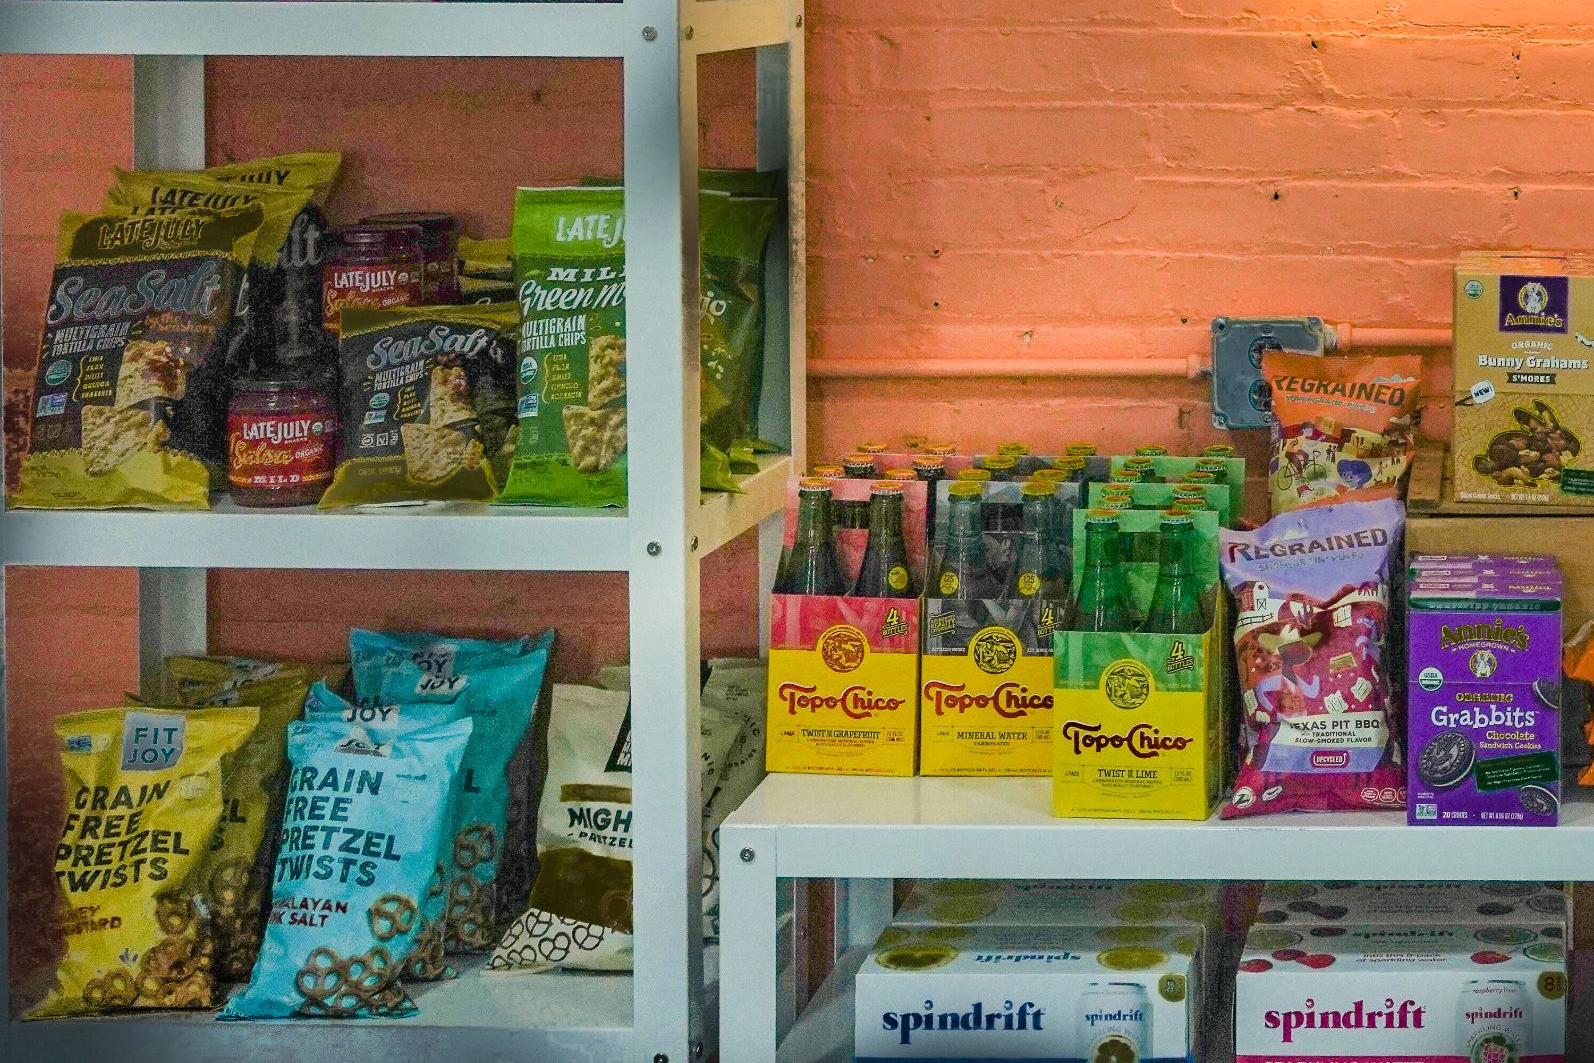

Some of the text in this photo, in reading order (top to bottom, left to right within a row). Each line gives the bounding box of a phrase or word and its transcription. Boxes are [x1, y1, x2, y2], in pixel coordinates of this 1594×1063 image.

[557, 213, 611, 243] LATE
[47, 260, 222, 325] Sea Salt
[334, 269, 398, 293] LATE JULY
[519, 279, 591, 316] Green
[53, 321, 131, 344] MULTIGRAIN
[558, 331, 587, 347] CHIPS
[52, 340, 97, 358] TORTILLA
[366, 336, 424, 371] Sea
[1478, 354, 1590, 371] Bunny Grahams
[1512, 374, 1551, 384] S'MORES
[1270, 375, 1407, 408] REGRAINED
[1473, 384, 1494, 398] NEW!
[243, 419, 312, 445] LATE JULY
[253, 474, 300, 484] MILD
[886, 607, 900, 626] 4
[1040, 607, 1054, 626] 4
[1440, 618, 1531, 649] Annie's
[1170, 641, 1186, 660] 4
[778, 681, 841, 717] Topo
[837, 684, 907, 720] Chico
[923, 680, 1055, 719] Topo Chico
[1456, 692, 1514, 703] ORGANIC
[346, 706, 394, 723] JOY
[1331, 719, 1381, 730] PIT BBQ
[1430, 704, 1535, 730] Grabbits
[133, 726, 179, 746] FIT
[800, 728, 882, 740] TWIST GRAPEFRUIT
[956, 730, 1028, 741] MINERAL WATER
[1062, 720, 1194, 759] Topo Chico
[1486, 730, 1535, 741] Chocolate
[127, 747, 178, 765] JOY
[289, 766, 386, 797] GRAIN
[1097, 768, 1159, 780] TWIST LIME
[74, 779, 173, 813] GRAIN
[285, 794, 354, 823] FREE
[60, 809, 145, 842] FREE
[54, 829, 191, 868] PRETZEL
[280, 823, 402, 862] PRETZEL
[54, 856, 170, 895] TWISTS
[278, 854, 379, 888] TWISTS
[288, 912, 330, 929] SALT
[1543, 975, 1557, 991] 8
[881, 999, 1046, 1046] spindrift
[1084, 1009, 1144, 1027] spindrift
[1263, 997, 1427, 1044] spindrift
[1464, 1006, 1524, 1025] spindrift
